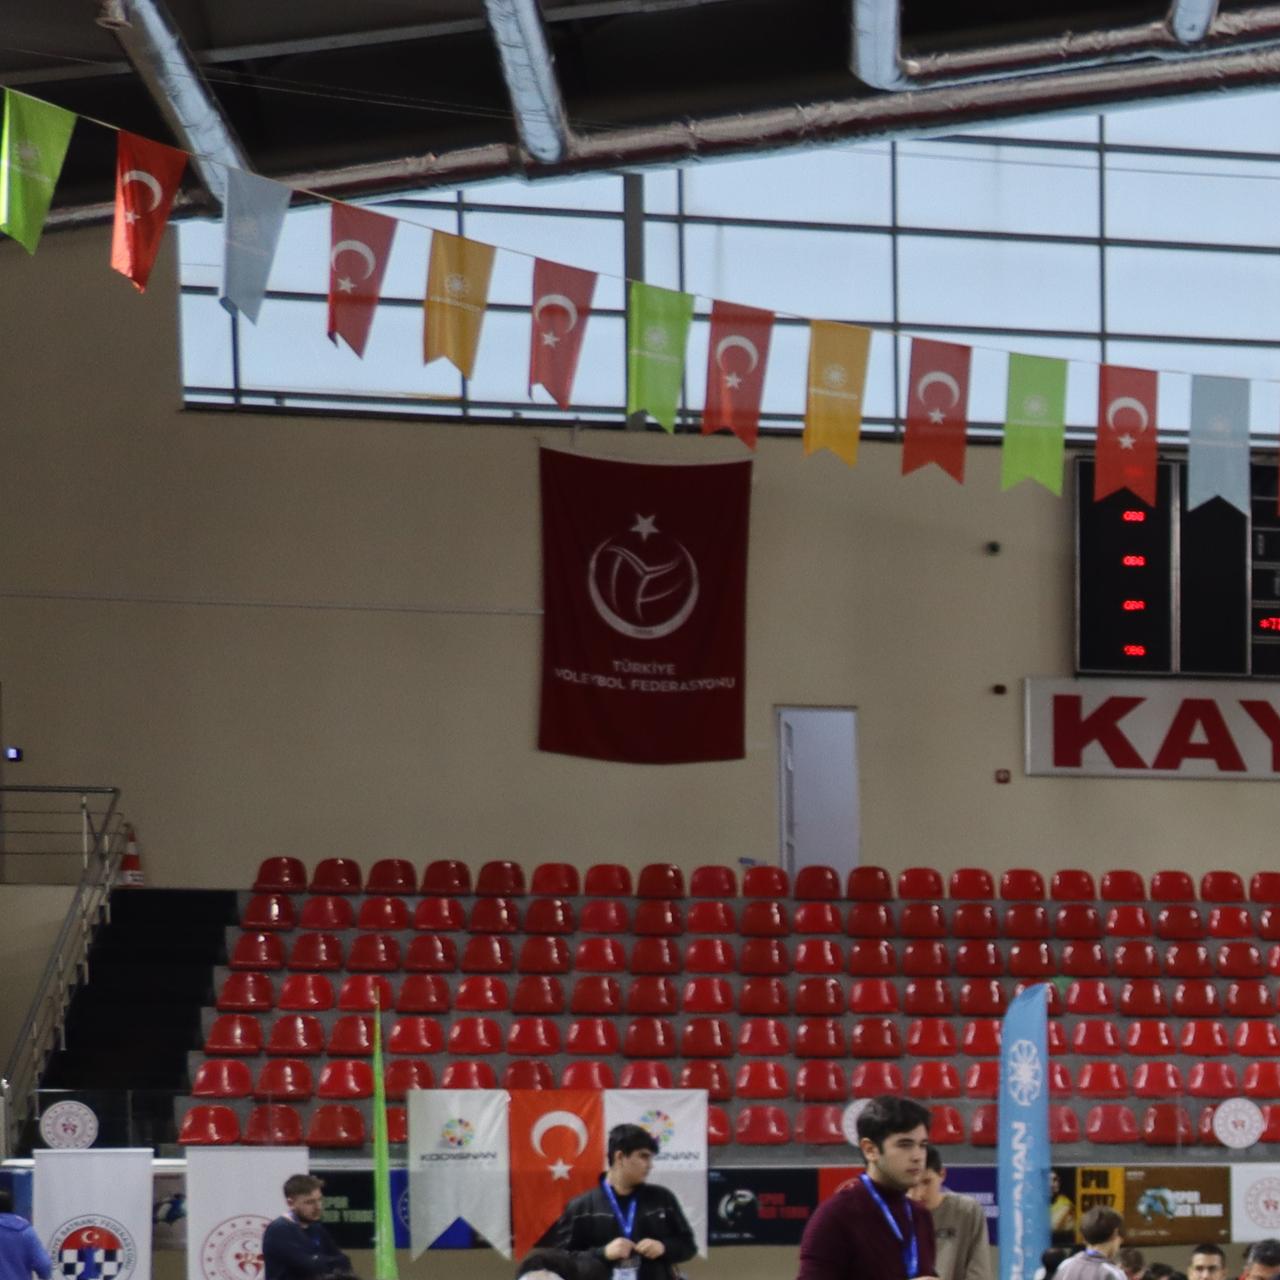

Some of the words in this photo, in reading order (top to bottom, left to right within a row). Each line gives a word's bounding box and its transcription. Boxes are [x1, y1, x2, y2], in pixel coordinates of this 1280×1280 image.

[613, 659, 677, 676] TÜRKİYE
[554, 667, 626, 690] VOLEYBOL
[630, 676, 737, 693] FEDERASYONU
